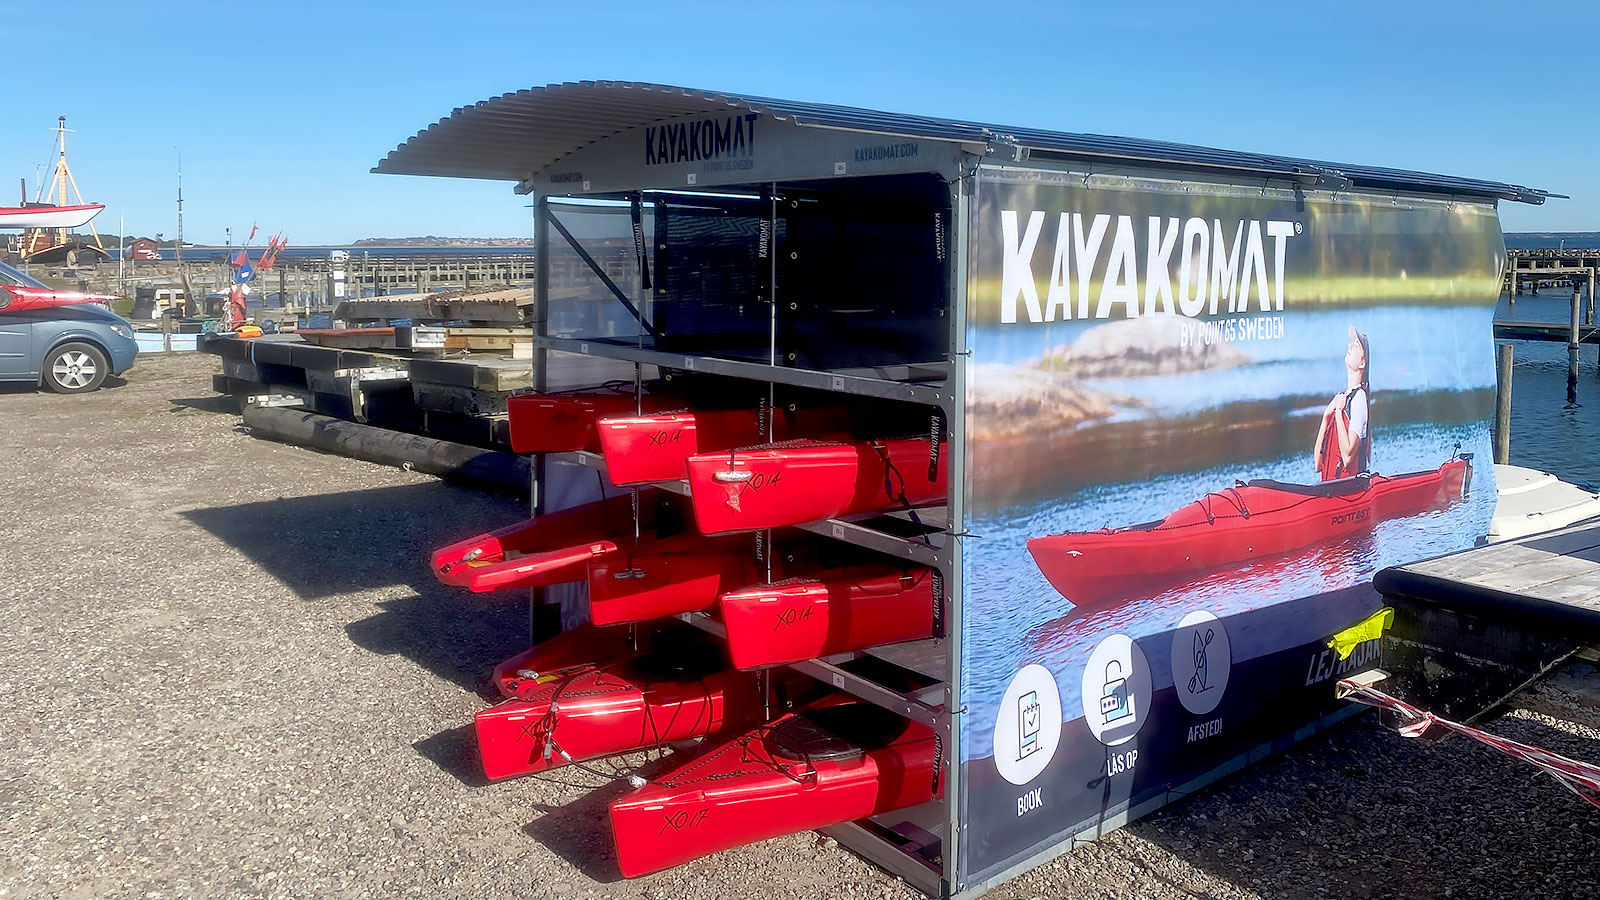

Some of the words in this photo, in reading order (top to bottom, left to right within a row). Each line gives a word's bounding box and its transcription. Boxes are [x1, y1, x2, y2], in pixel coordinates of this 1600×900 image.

[645, 114, 758, 166] KAYAKOMAT
[854, 142, 919, 162] KAYAKOMAT.COM
[758, 217, 769, 258] KAYAKOMAT
[1180, 323, 1196, 348] BY
[1199, 319, 1225, 346] POINT
[1224, 319, 1237, 343] 65
[1238, 316, 1285, 341] SWEDEN
[930, 415, 940, 465] KAYAKOMAT
[1305, 648, 1337, 687] LEJ
[1187, 717, 1223, 743] AFSTED!
[1107, 752, 1125, 777] LÅS
[1126, 749, 1139, 770] OP
[1017, 787, 1043, 817] BOOK
